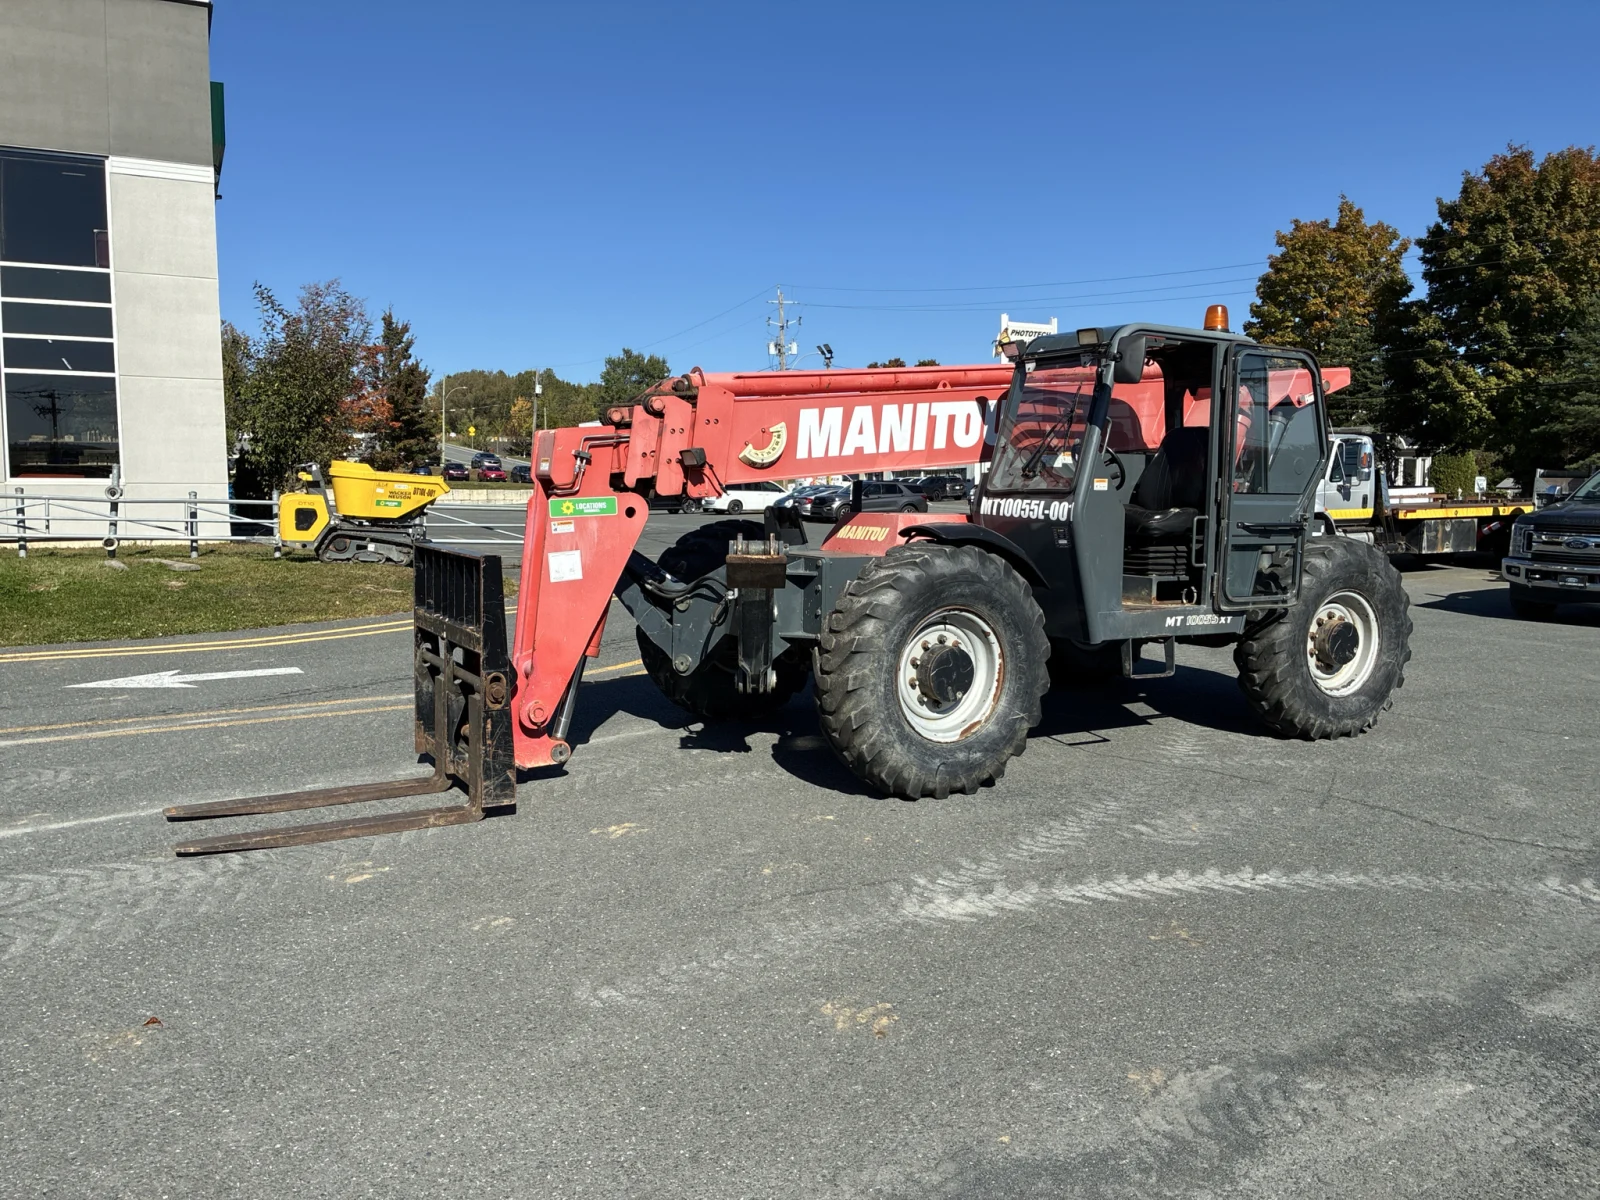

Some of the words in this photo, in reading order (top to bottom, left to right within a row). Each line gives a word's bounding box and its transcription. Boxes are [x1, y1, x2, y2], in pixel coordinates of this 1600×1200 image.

[575, 501, 607, 510] LOCATIONS
[980, 496, 1075, 522] MT10055L-001
[836, 525, 890, 542] MANITOU
[1165, 615, 1185, 627] MT
